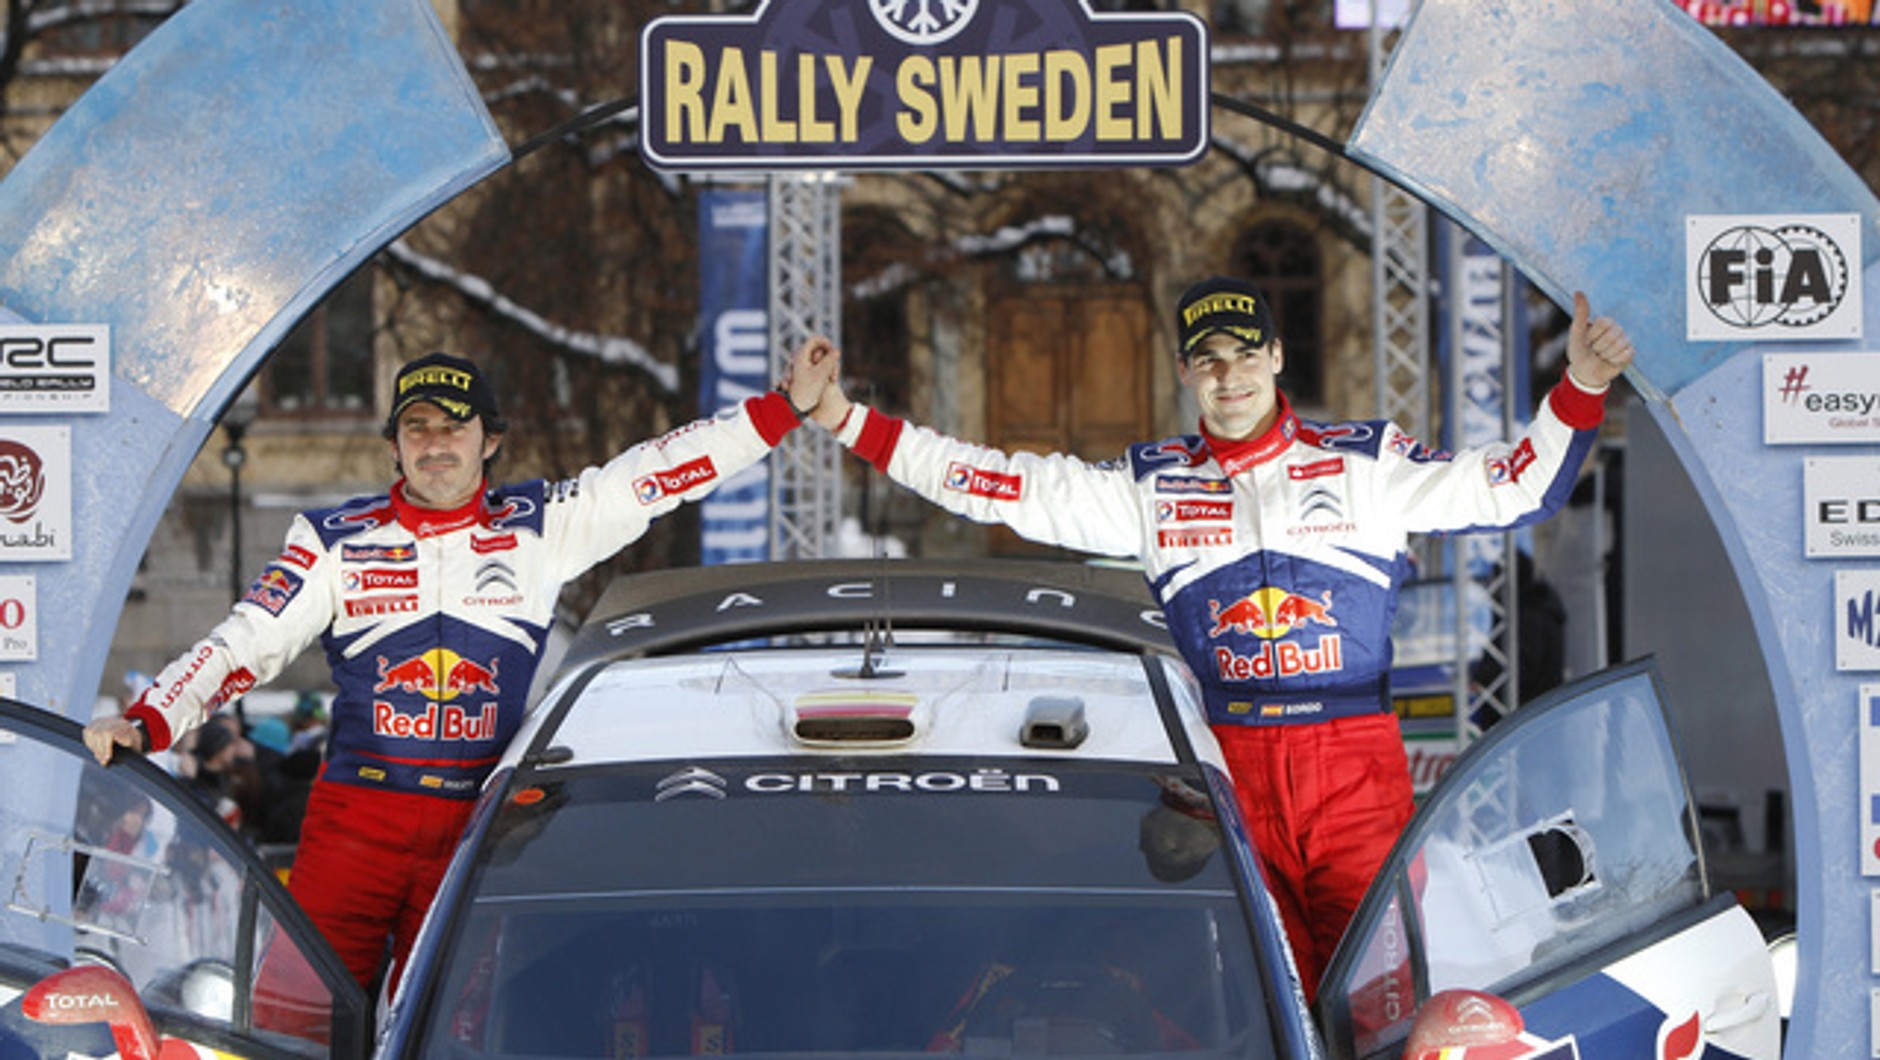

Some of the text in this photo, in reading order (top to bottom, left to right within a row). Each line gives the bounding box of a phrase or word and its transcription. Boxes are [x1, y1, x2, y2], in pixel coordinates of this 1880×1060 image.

[664, 35, 1183, 144] RALLY SWEDEN
[1183, 292, 1255, 328] PIRELLI
[0, 337, 95, 367] RC
[399, 364, 472, 395] PIRELLI
[660, 466, 713, 489] TOTAL
[973, 474, 1018, 495] TOTAL
[1178, 504, 1229, 517] TOTAL
[366, 572, 413, 586] TOTAL
[344, 594, 418, 617] PIRELLI
[1214, 633, 1342, 682] Red Bull
[373, 700, 497, 741] Red Bull
[44, 992, 119, 1010] TOTAL
